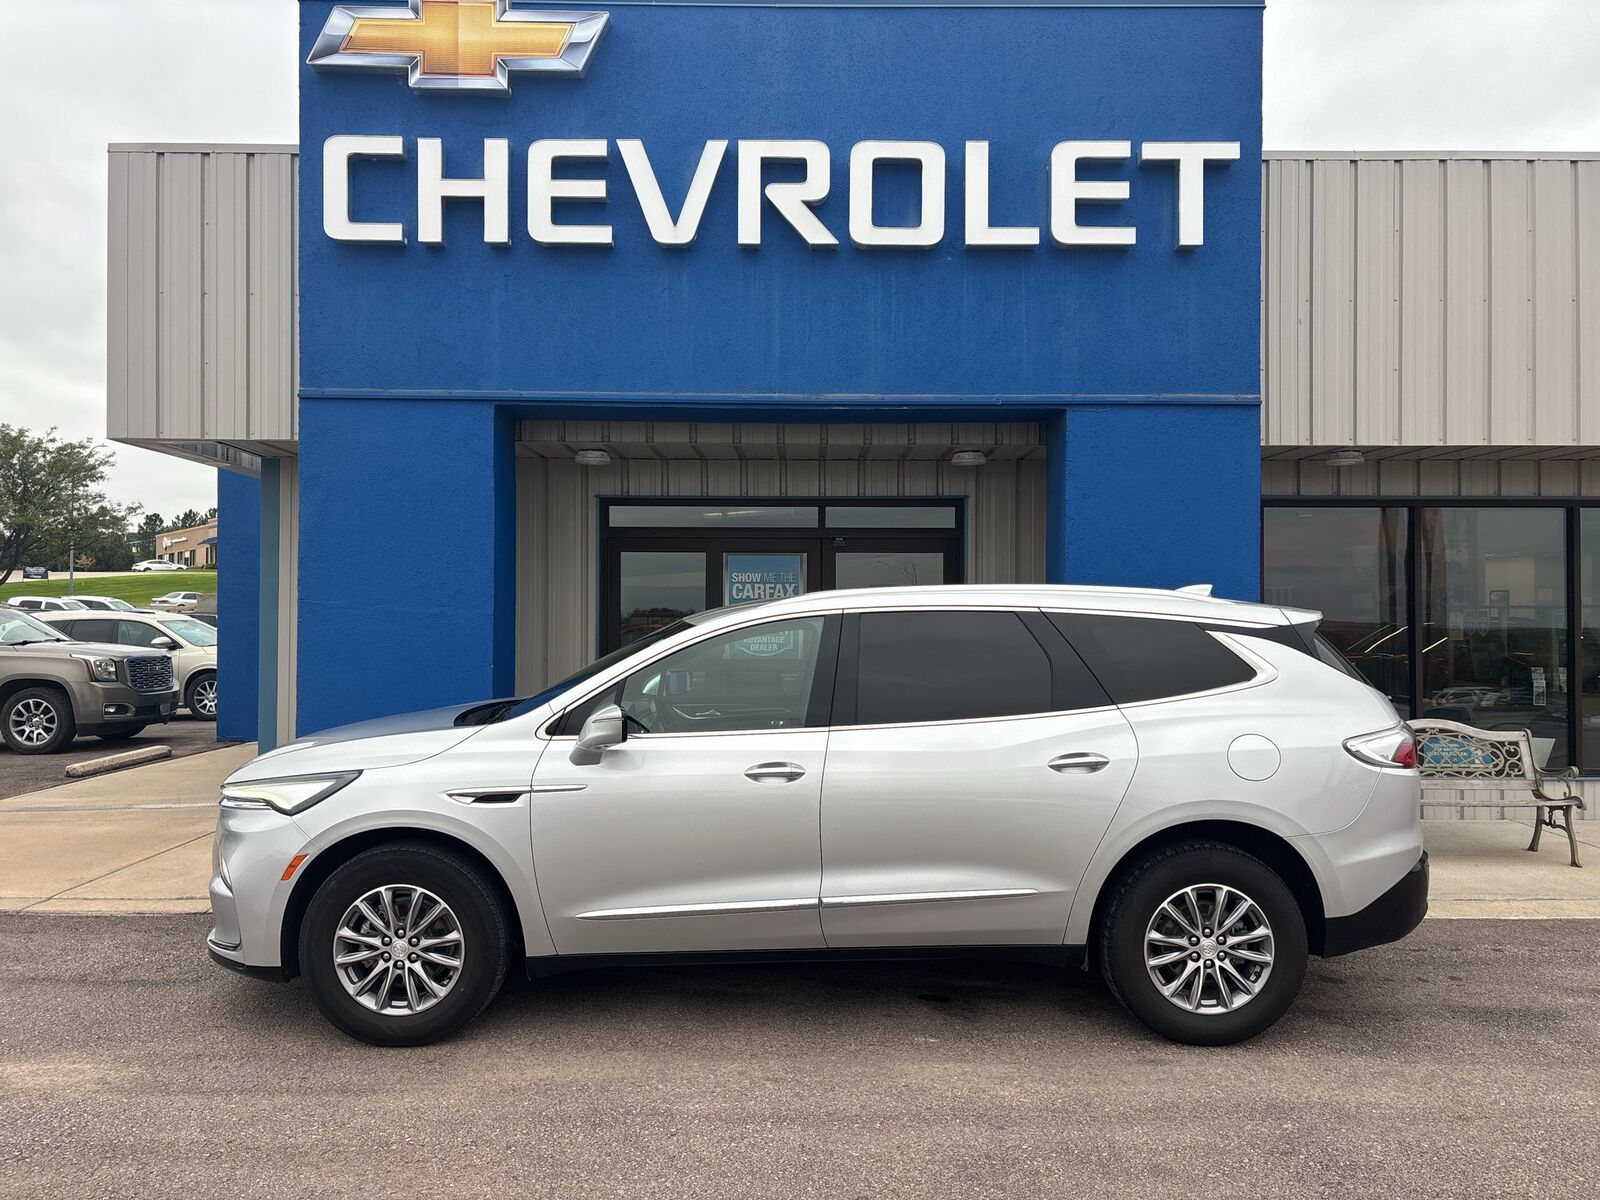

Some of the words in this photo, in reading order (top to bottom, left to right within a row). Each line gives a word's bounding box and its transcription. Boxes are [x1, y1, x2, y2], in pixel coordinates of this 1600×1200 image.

[322, 134, 1242, 249] CHEVROLET
[732, 572, 761, 582] SHOW
[763, 572, 777, 582] ME
[779, 572, 796, 582] THE
[732, 583, 796, 599] CARFAX
